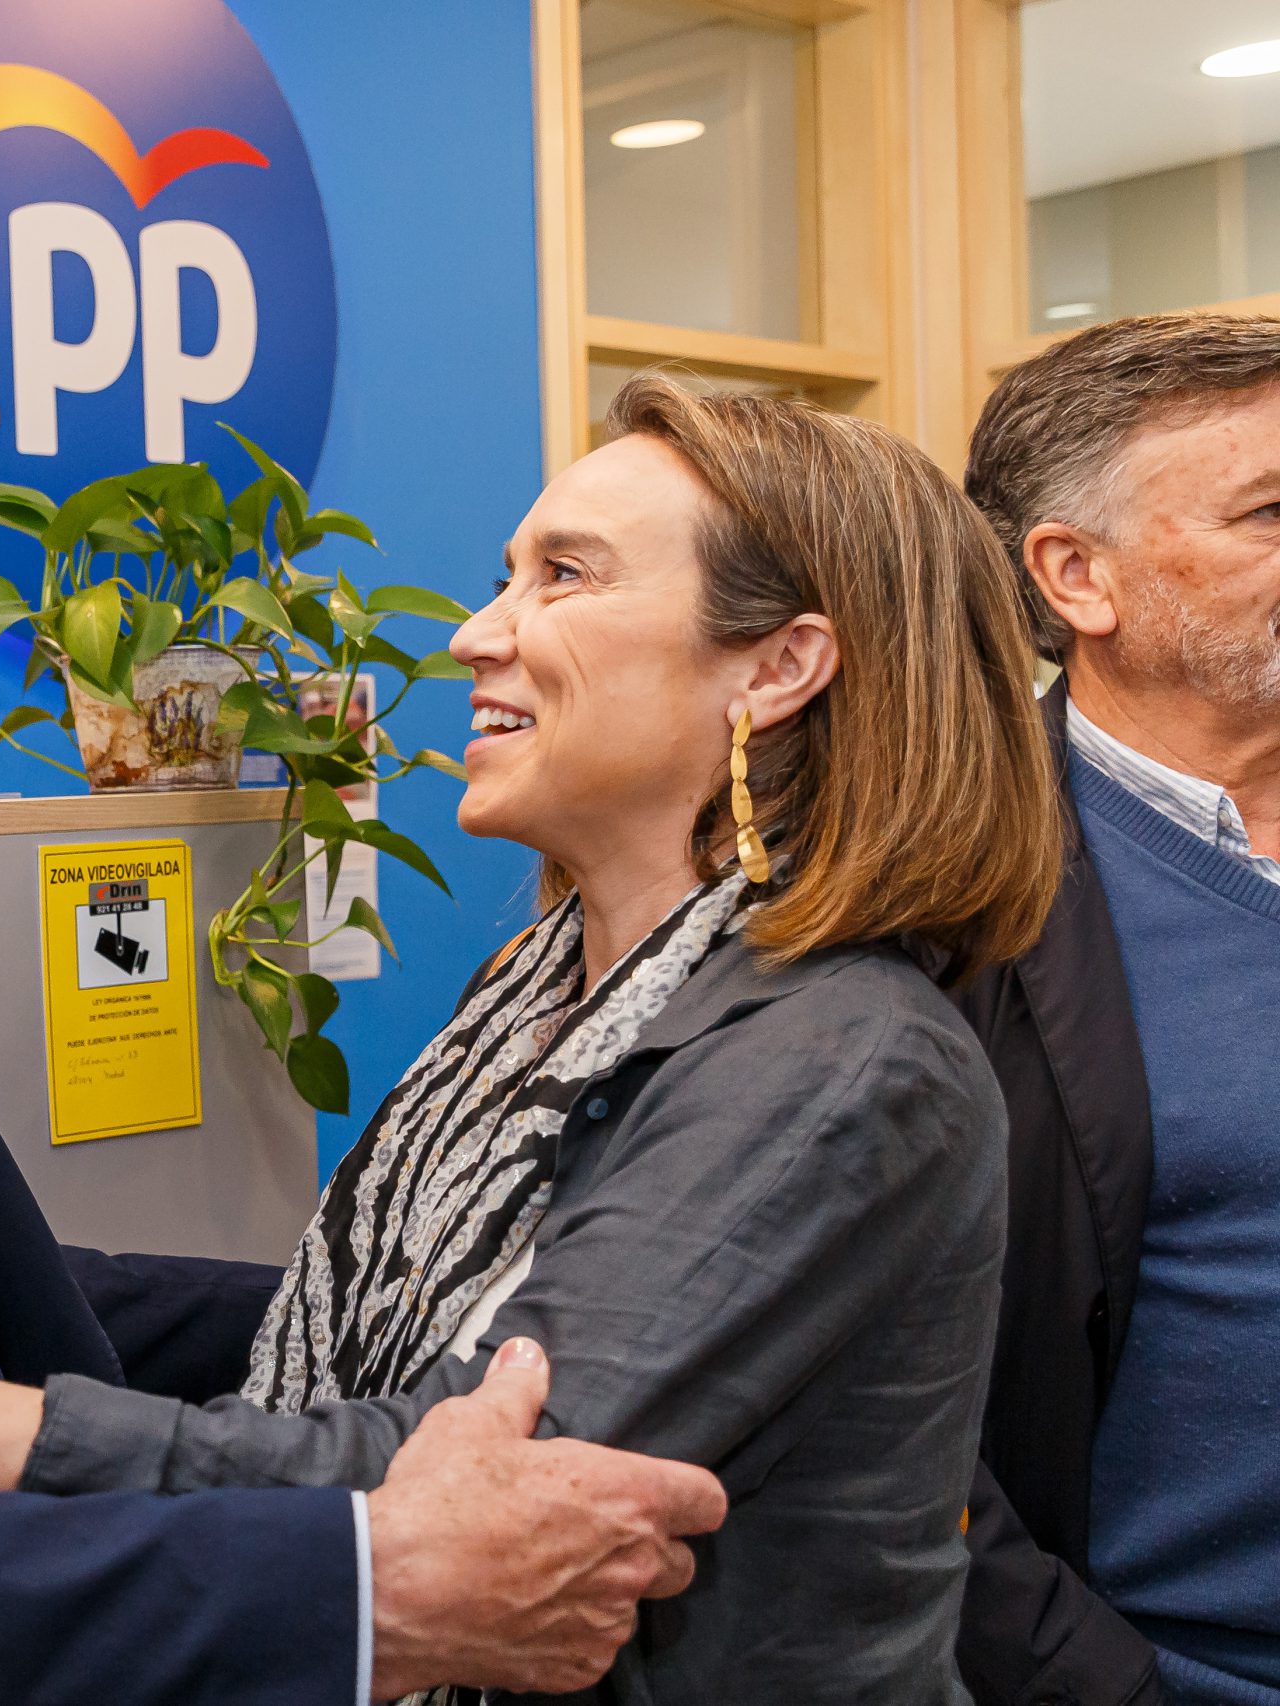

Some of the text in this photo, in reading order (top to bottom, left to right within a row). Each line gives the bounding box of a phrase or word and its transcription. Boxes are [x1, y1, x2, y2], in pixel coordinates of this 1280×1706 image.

[50, 860, 180, 885] ZONA VIDEOVIGILADA
[109, 884, 142, 899] Drin
